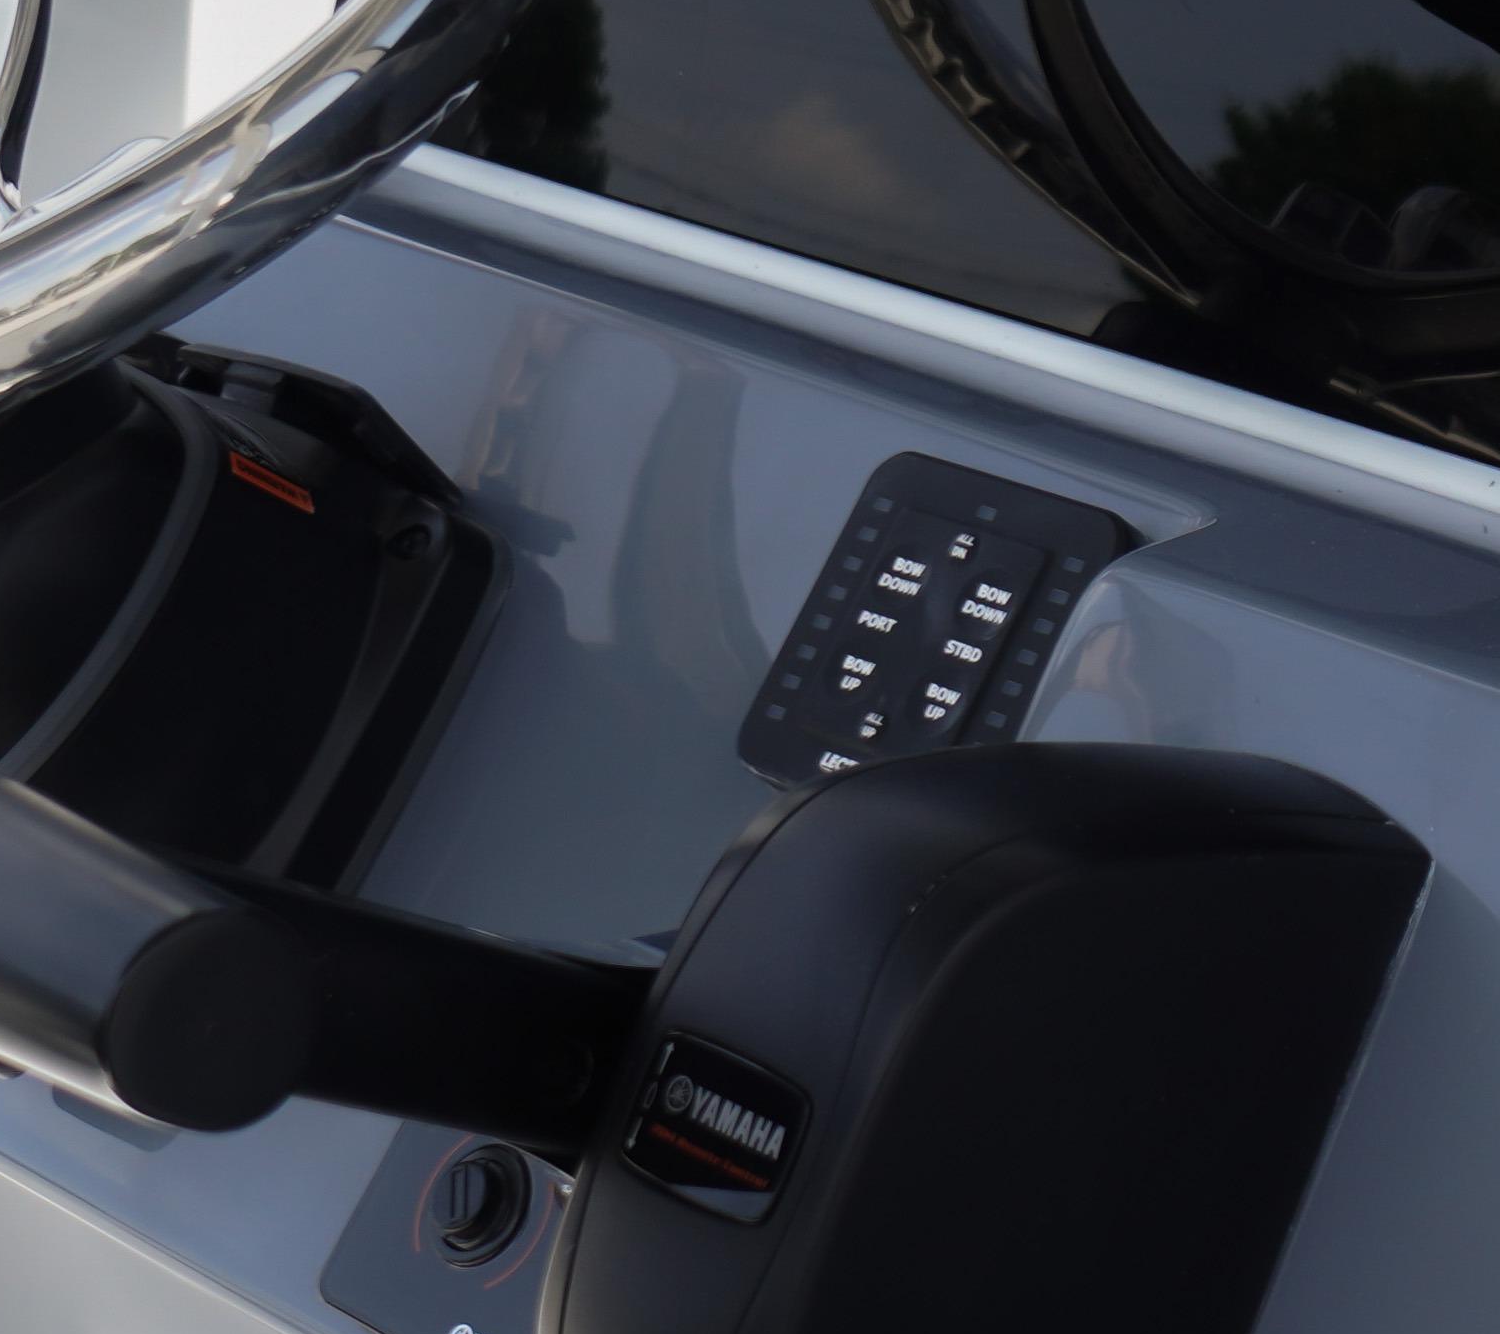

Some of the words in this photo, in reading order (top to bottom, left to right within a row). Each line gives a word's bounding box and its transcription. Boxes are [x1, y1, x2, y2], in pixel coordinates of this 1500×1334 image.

[892, 556, 926, 577] BOW
[877, 572, 922, 596] DOWN
[976, 583, 1012, 605] BOW
[857, 610, 898, 633] PORT
[961, 600, 1007, 624] DOWN
[943, 639, 983, 662] STBD
[842, 654, 876, 676] BOW
[840, 675, 861, 691] UP
[925, 683, 961, 705] BOW
[924, 704, 946, 720] UP
[860, 725, 877, 738] UP
[691, 1086, 786, 1161] YAMAHA
